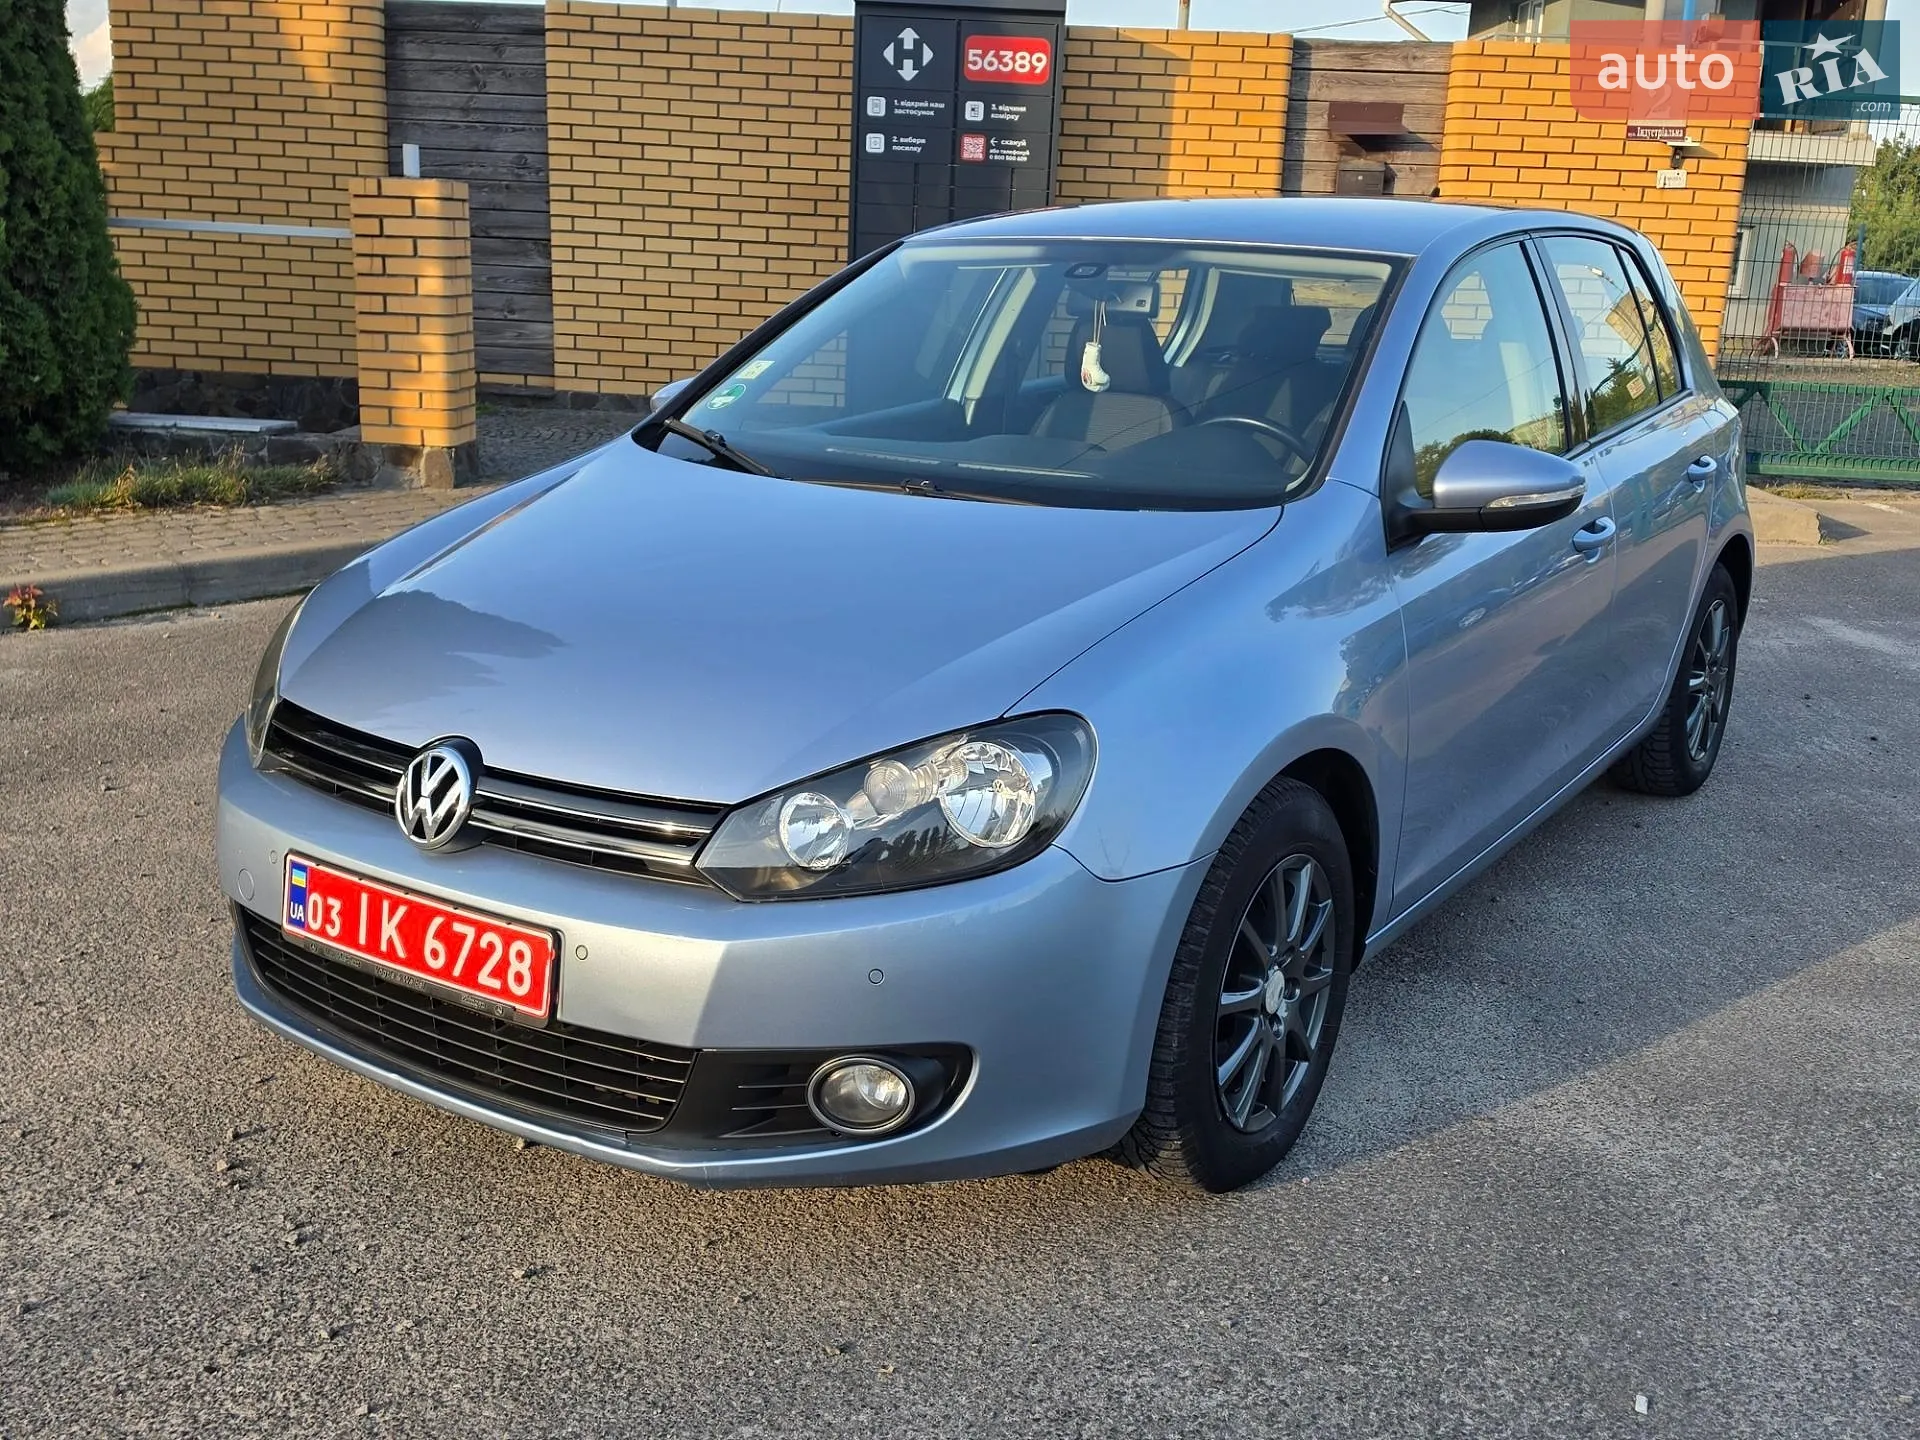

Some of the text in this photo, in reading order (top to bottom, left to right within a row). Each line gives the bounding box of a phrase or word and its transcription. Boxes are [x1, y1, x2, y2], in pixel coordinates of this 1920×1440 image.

[967, 49, 1048, 74] 56389
[290, 901, 305, 923] UA
[307, 892, 342, 938] 03
[359, 892, 408, 959] IK
[424, 916, 533, 998] 6728
